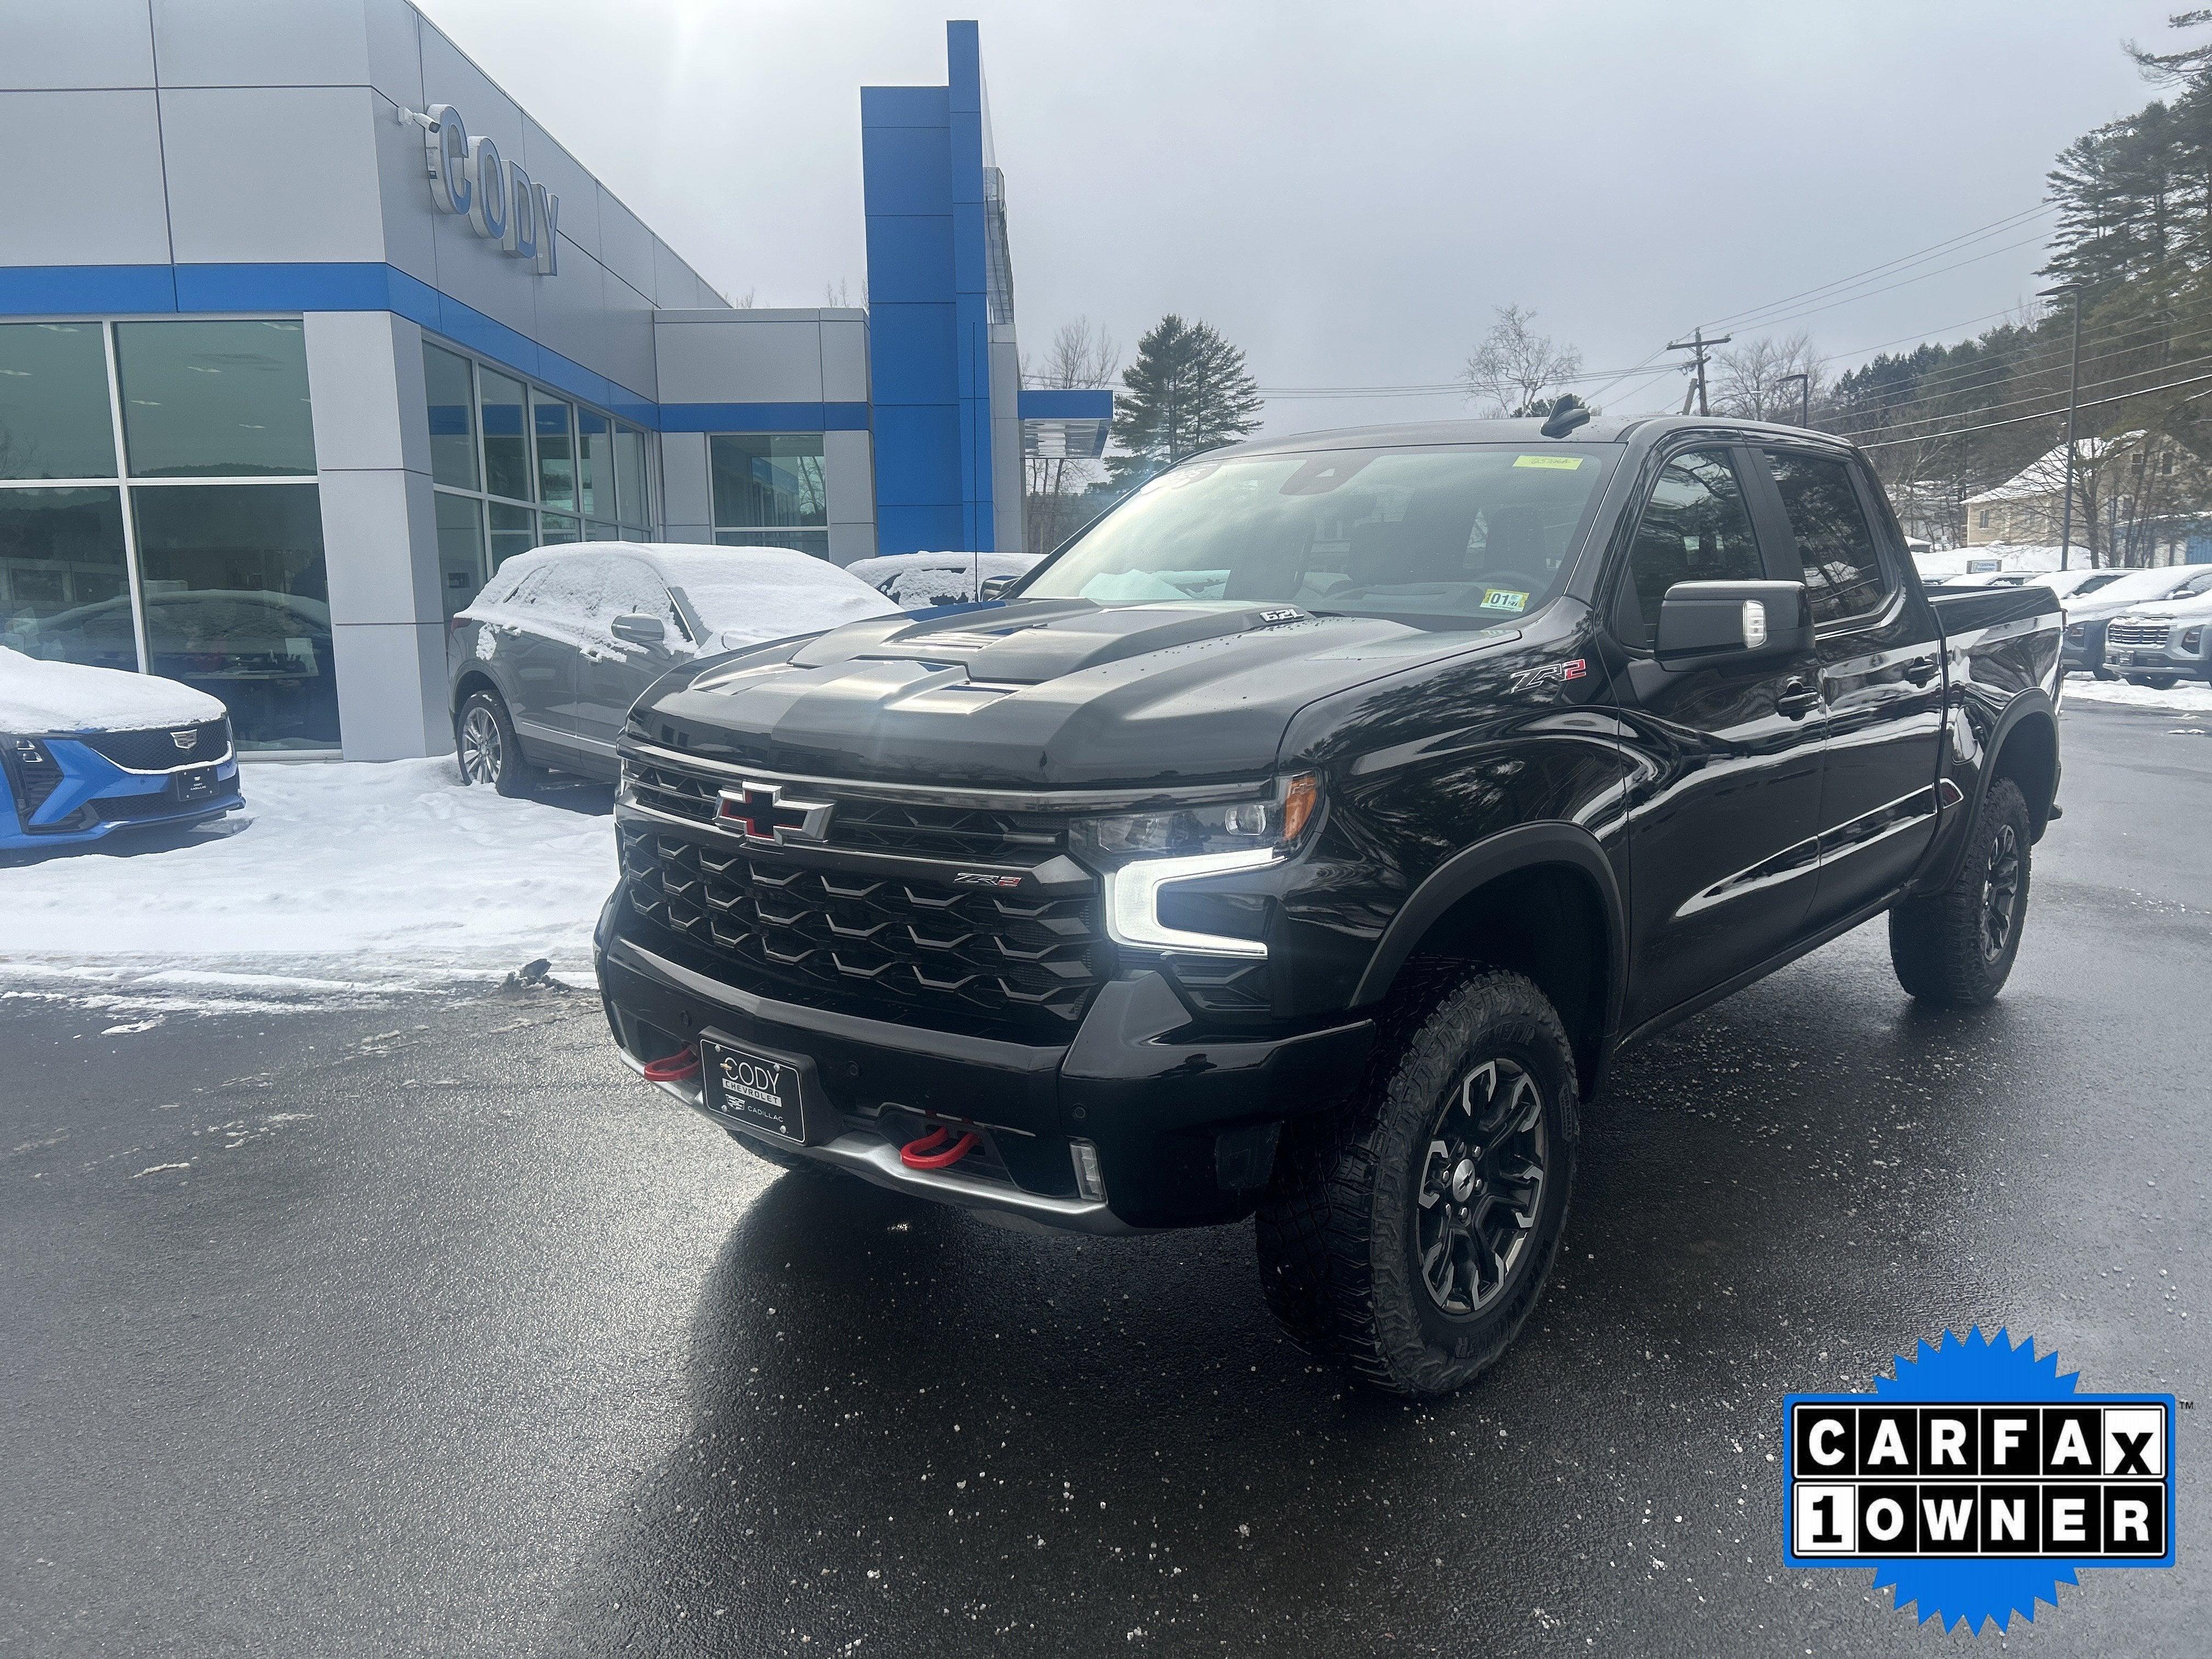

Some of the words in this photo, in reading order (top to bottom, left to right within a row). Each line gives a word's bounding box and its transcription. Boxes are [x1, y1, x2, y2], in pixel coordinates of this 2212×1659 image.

[426, 104, 558, 276] CODY
[1491, 593, 1509, 605] 01
[1510, 658, 1587, 694] ZR2
[953, 872, 1023, 888] ZR2
[723, 1057, 780, 1094] CODY
[725, 1080, 778, 1104] CHEVROLET
[747, 1105, 784, 1122] CADILLAC
